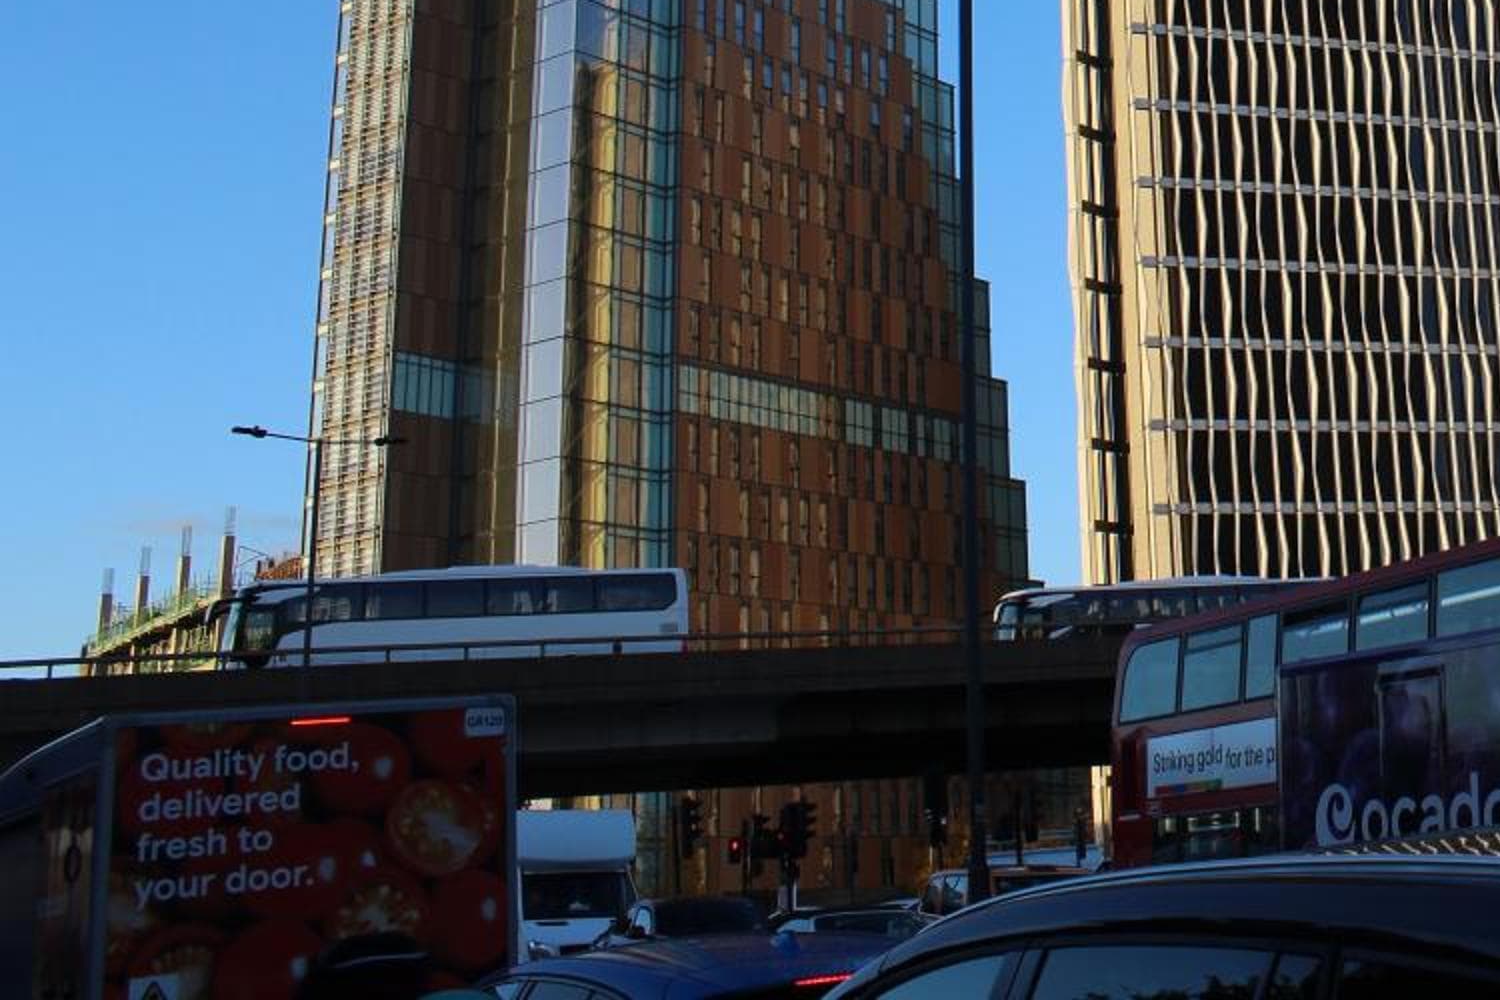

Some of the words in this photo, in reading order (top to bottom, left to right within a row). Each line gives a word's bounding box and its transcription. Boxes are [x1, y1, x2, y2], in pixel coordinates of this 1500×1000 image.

[139, 748, 265, 784] Quality
[274, 741, 360, 776] food,
[1153, 749, 1195, 775] Striking
[1196, 743, 1223, 772] gold
[1225, 745, 1242, 769] for
[1244, 746, 1263, 766] the
[137, 782, 302, 823] delivered
[136, 826, 228, 864] fresh
[238, 826, 274, 853] to
[134, 872, 218, 913] your
[224, 863, 315, 895] door.
